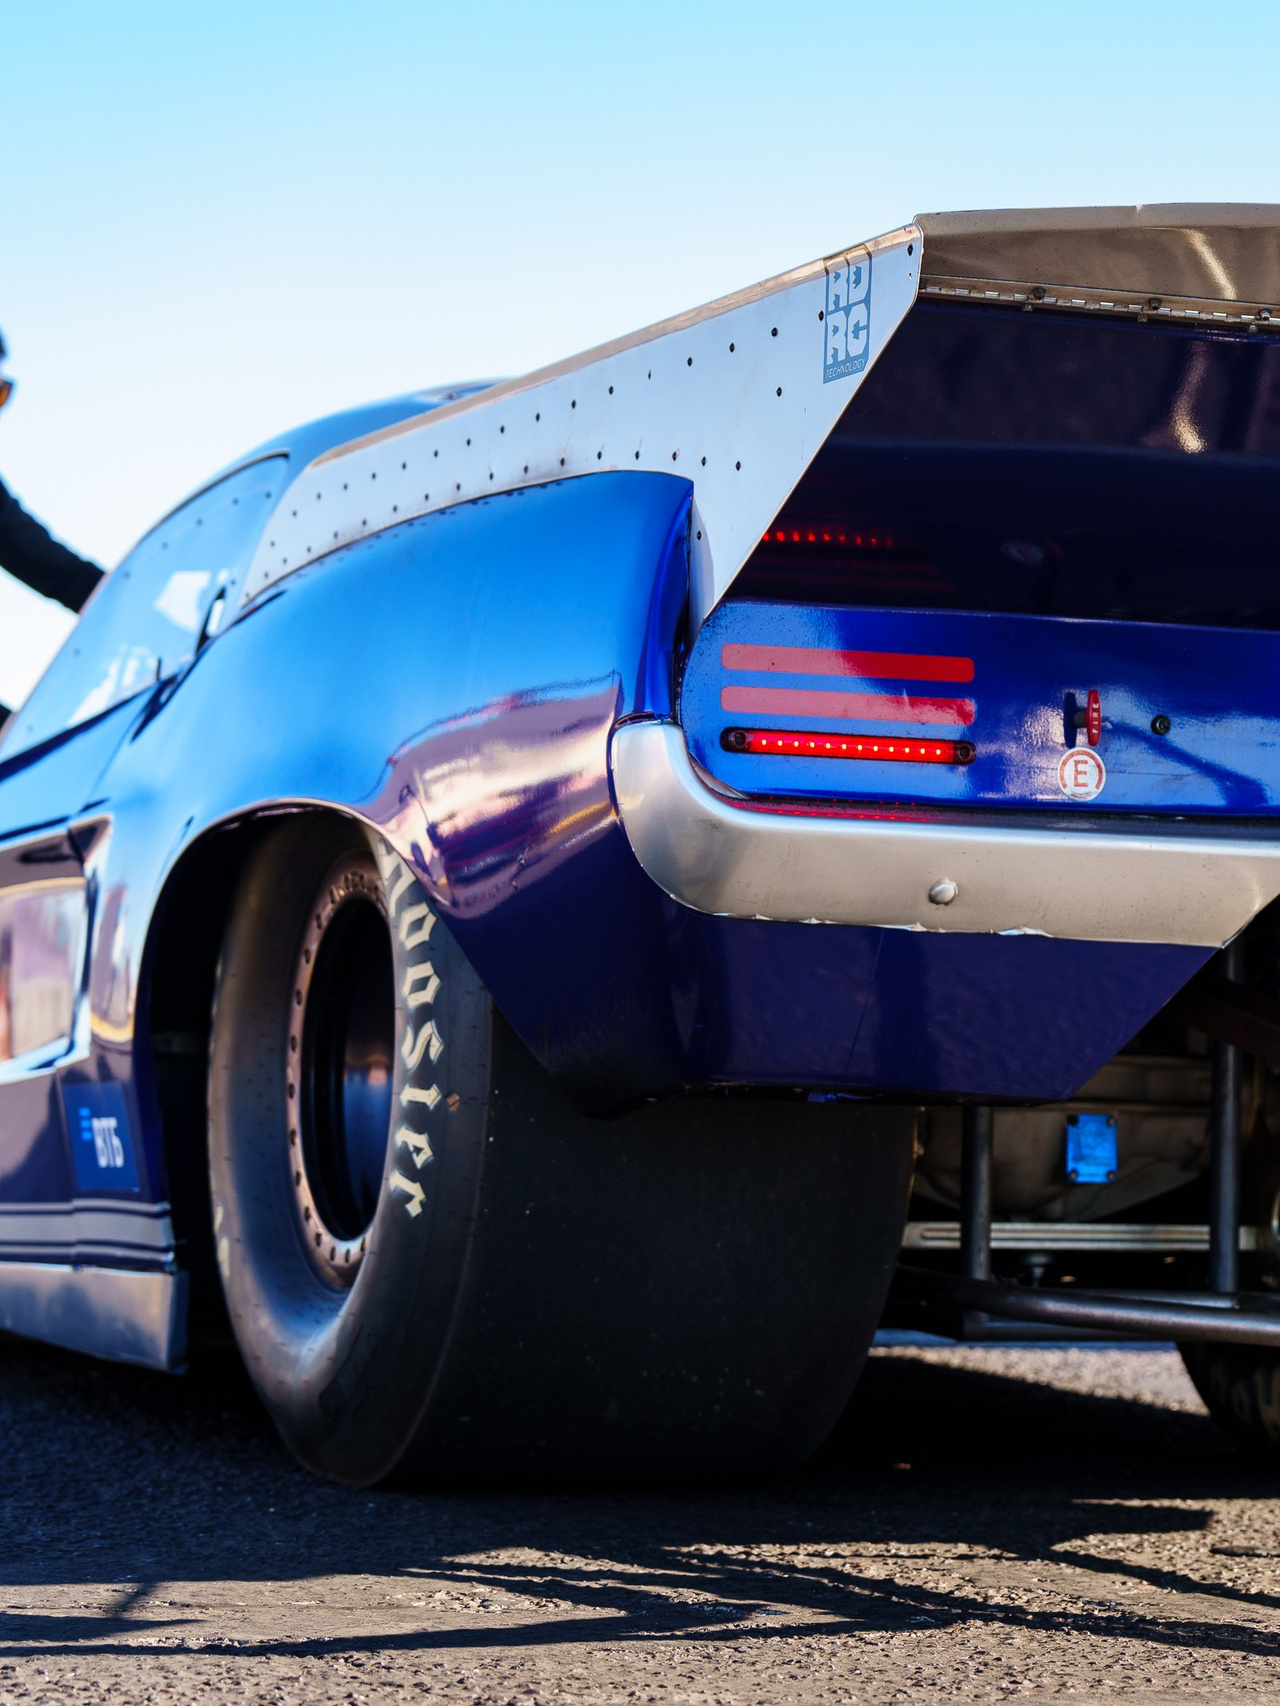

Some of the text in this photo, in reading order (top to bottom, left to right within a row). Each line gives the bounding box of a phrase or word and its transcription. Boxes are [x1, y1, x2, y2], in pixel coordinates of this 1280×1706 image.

[825, 357, 866, 379] TECHNOLOGY
[1092, 702, 1100, 734] FIRE
[1073, 759, 1089, 787] E
